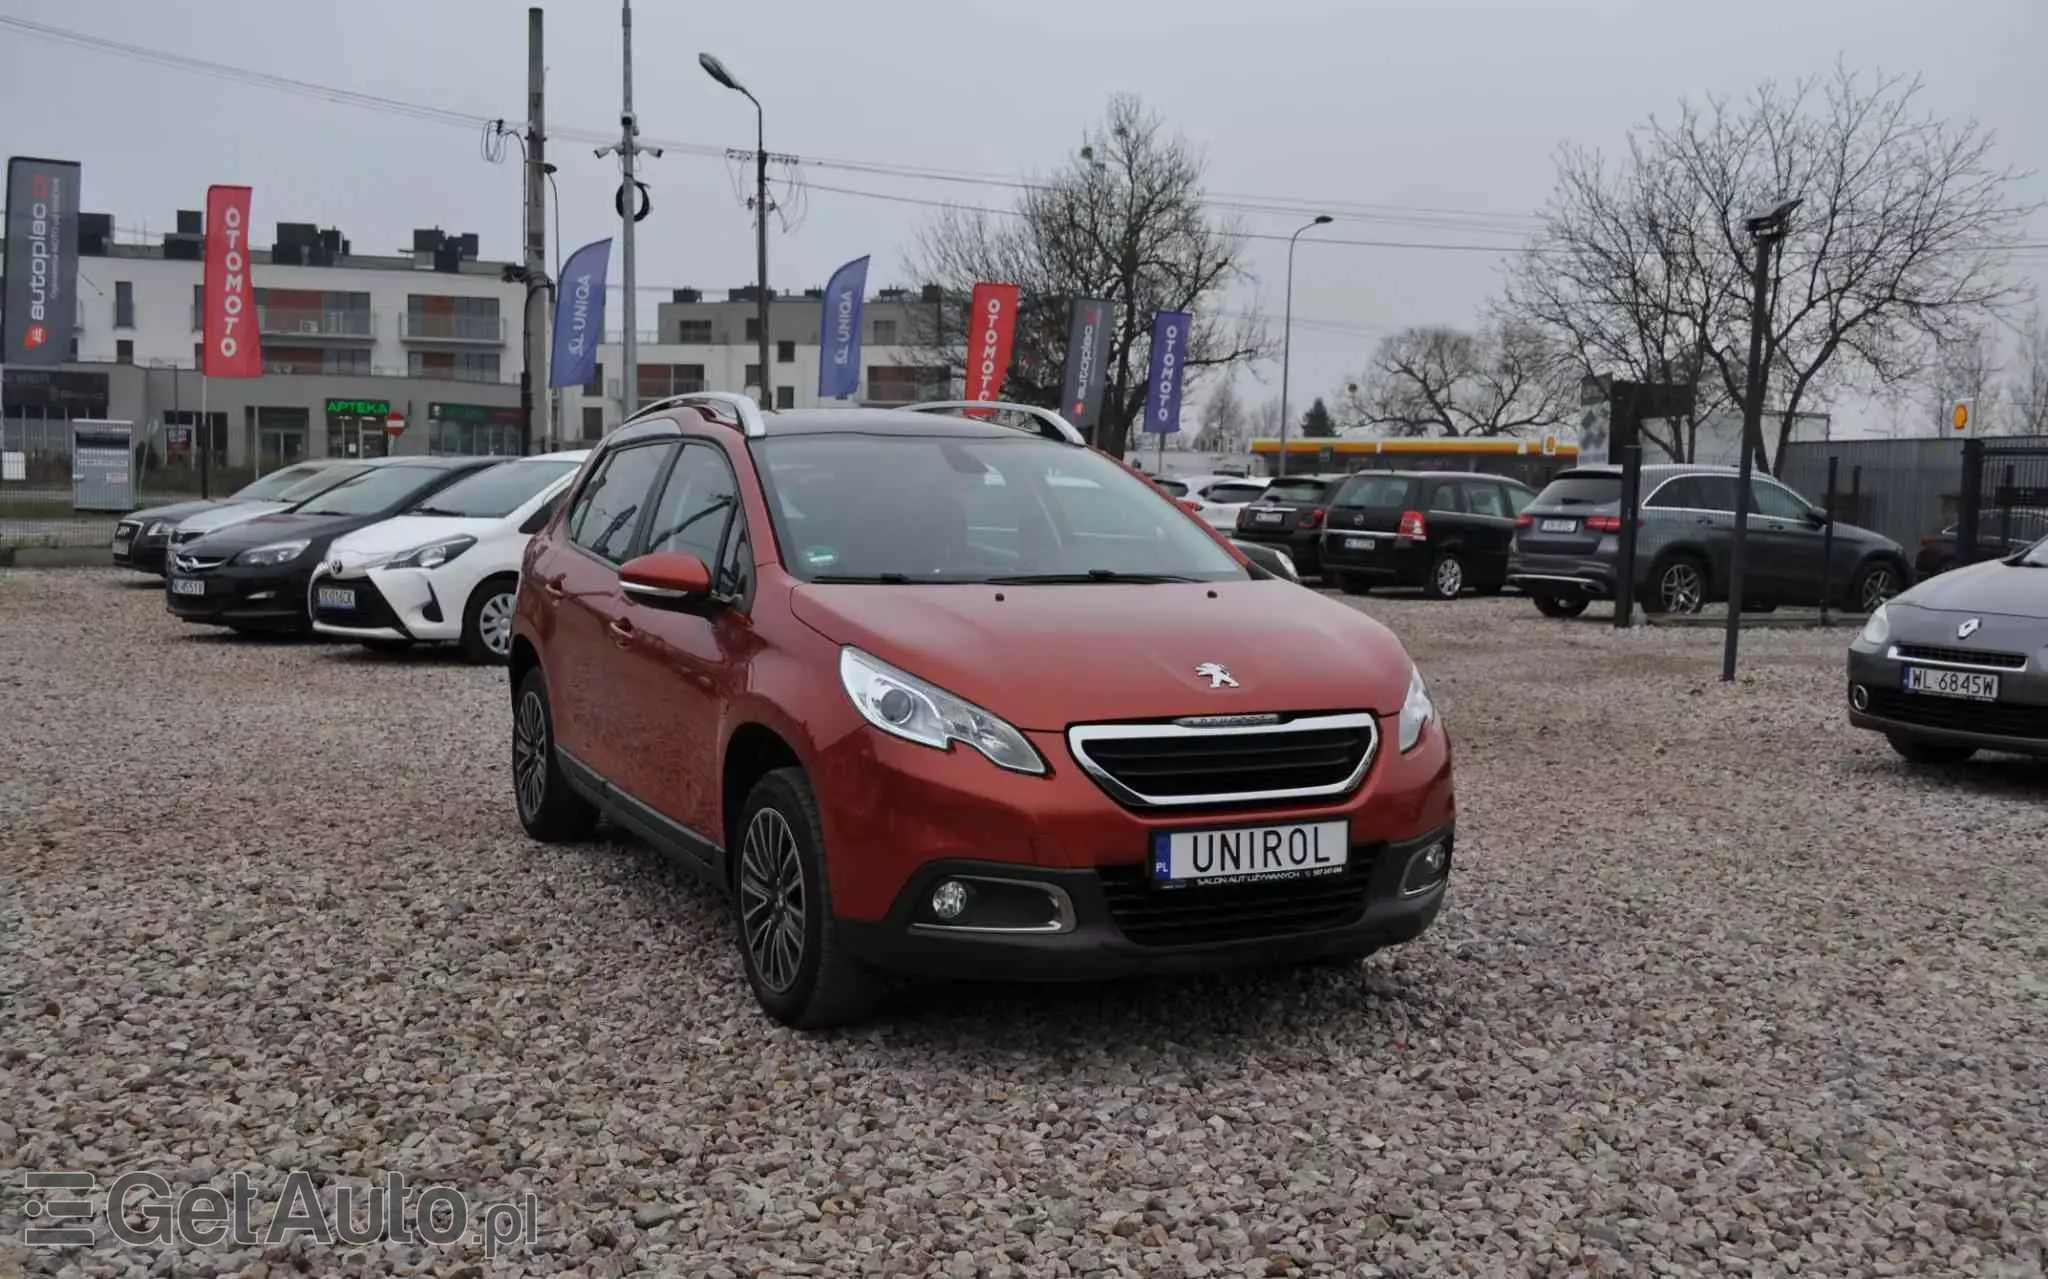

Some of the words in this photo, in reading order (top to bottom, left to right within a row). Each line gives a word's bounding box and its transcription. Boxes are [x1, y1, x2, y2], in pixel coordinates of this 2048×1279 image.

[28, 203, 50, 320] autoplac
[220, 207, 242, 357] OTOMOTO
[573, 273, 591, 330] UNIQA
[836, 290, 853, 342] UNIQA
[1077, 325, 1093, 399] autoplac
[1158, 325, 1178, 421] OTOMOTO
[327, 401, 388, 413] APTEKA
[1912, 669, 1932, 689] WL
[1938, 672, 1994, 697] 6845W
[1155, 862, 1168, 873] PL
[1192, 825, 1330, 873] UNIROL
[1196, 876, 1227, 886] SALON
